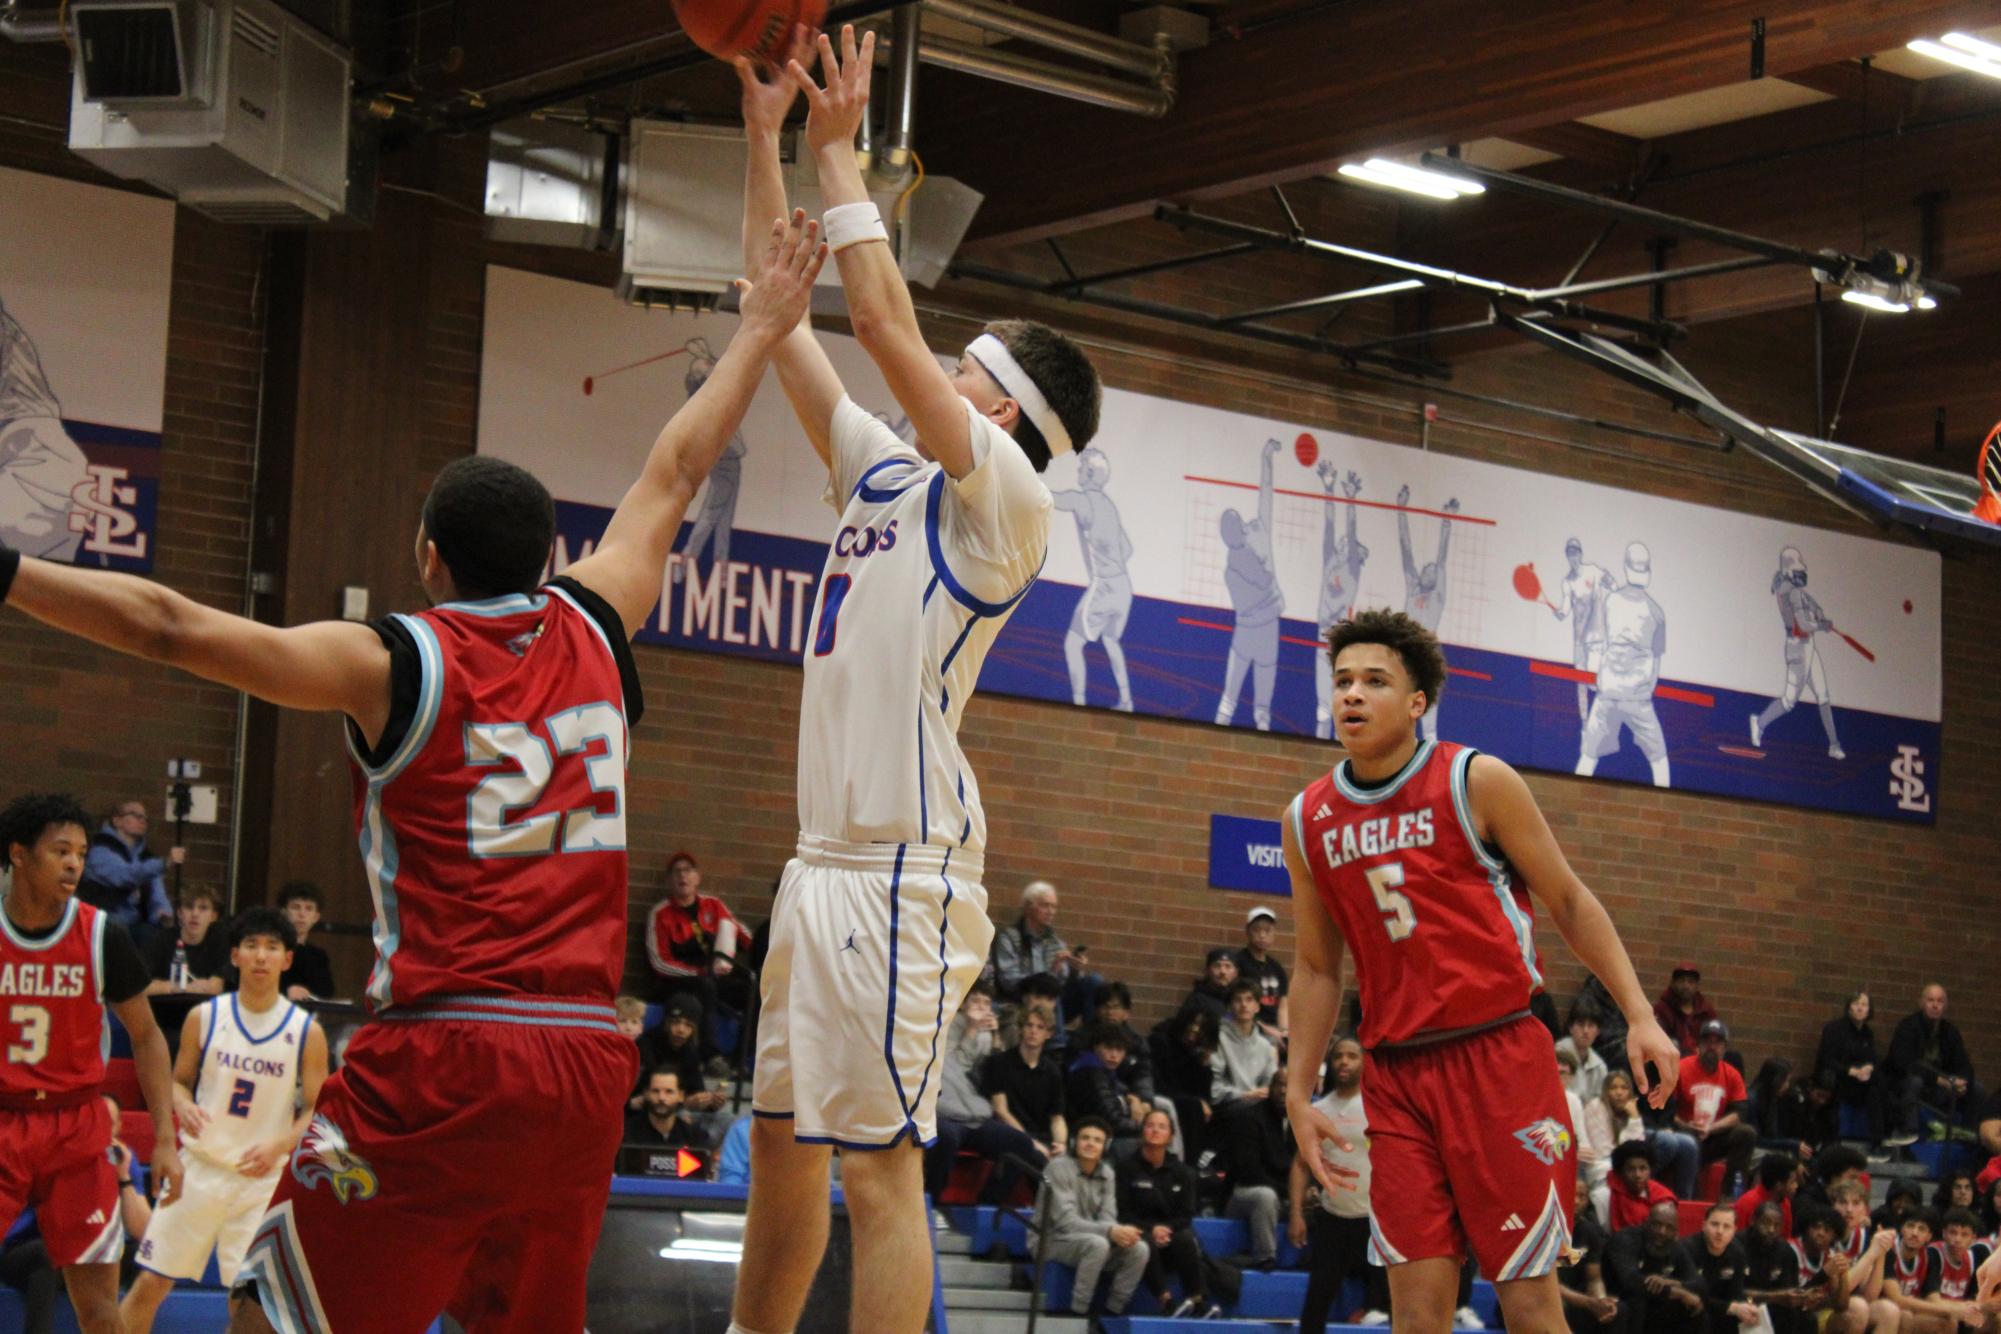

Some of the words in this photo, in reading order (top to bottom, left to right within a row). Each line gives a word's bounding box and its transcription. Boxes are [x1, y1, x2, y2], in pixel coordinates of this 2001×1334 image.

[463, 700, 628, 860] 23
[1246, 843, 1287, 869] VISIT
[1322, 807, 1436, 870] EAGLES
[1364, 861, 1418, 943] 5
[0, 962, 86, 998] AGLES
[7, 1004, 52, 1066] 3
[227, 1077, 256, 1119] 2
